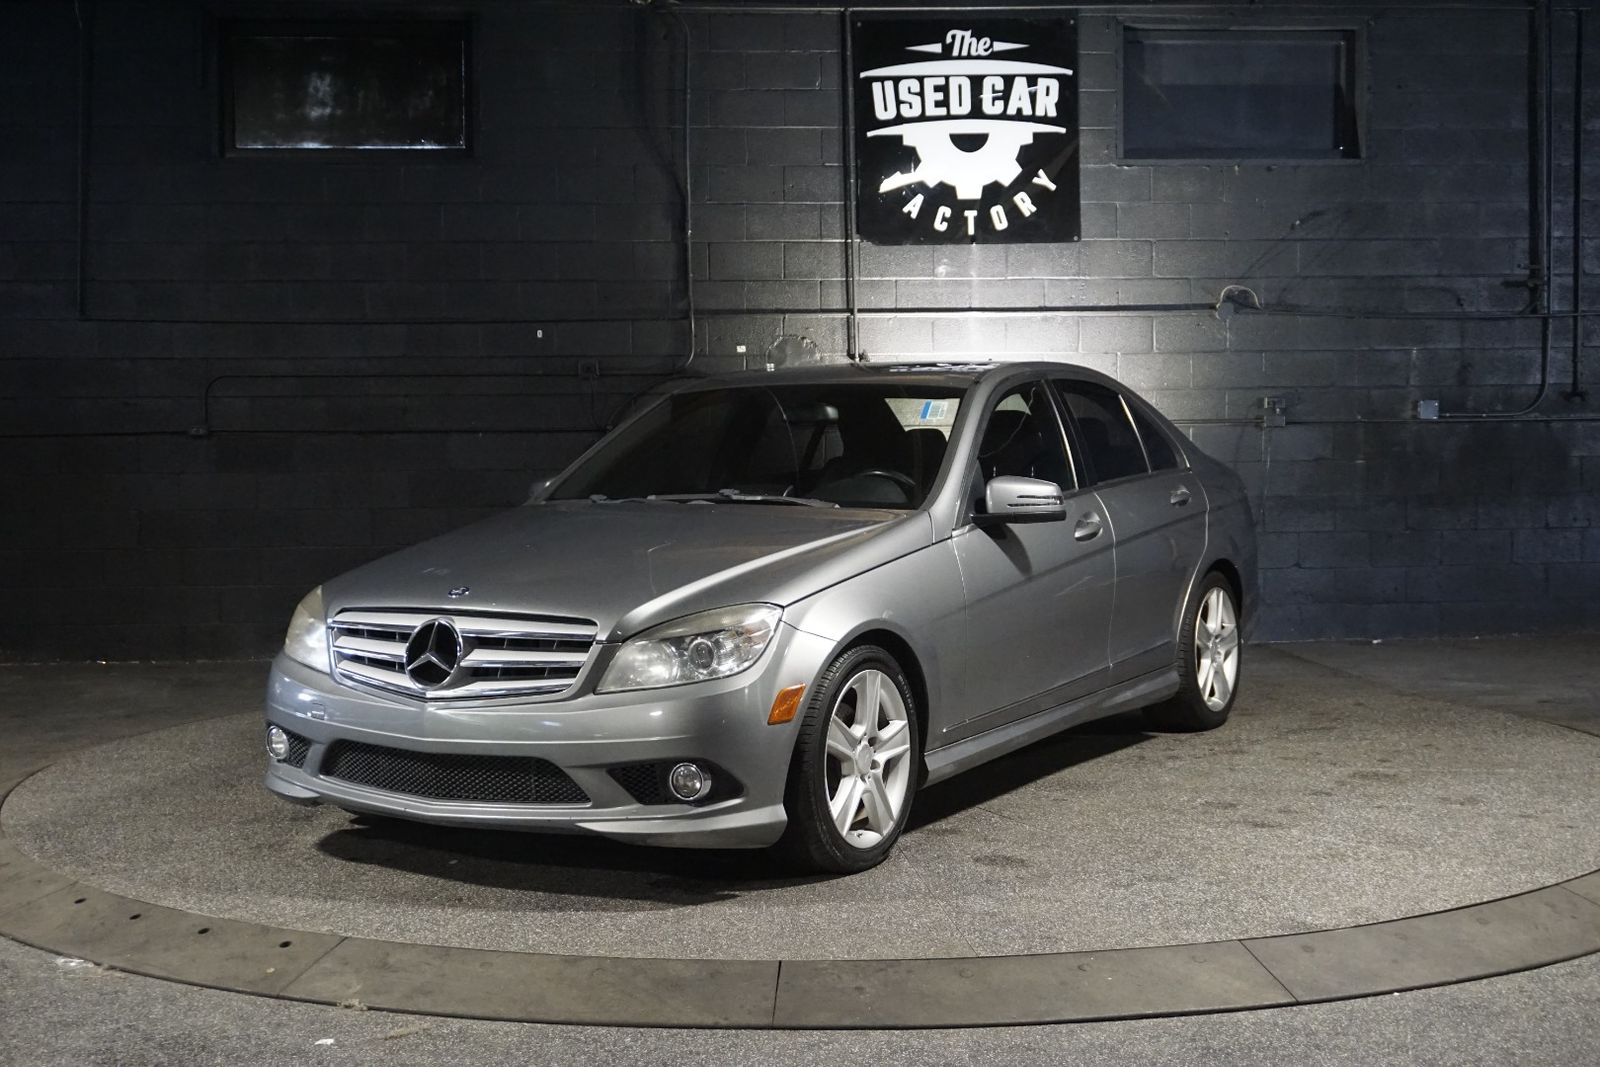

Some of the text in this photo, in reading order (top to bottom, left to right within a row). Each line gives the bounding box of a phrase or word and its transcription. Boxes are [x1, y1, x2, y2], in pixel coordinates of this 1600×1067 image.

[946, 29, 993, 57] The
[872, 75, 1060, 121] USED CAR
